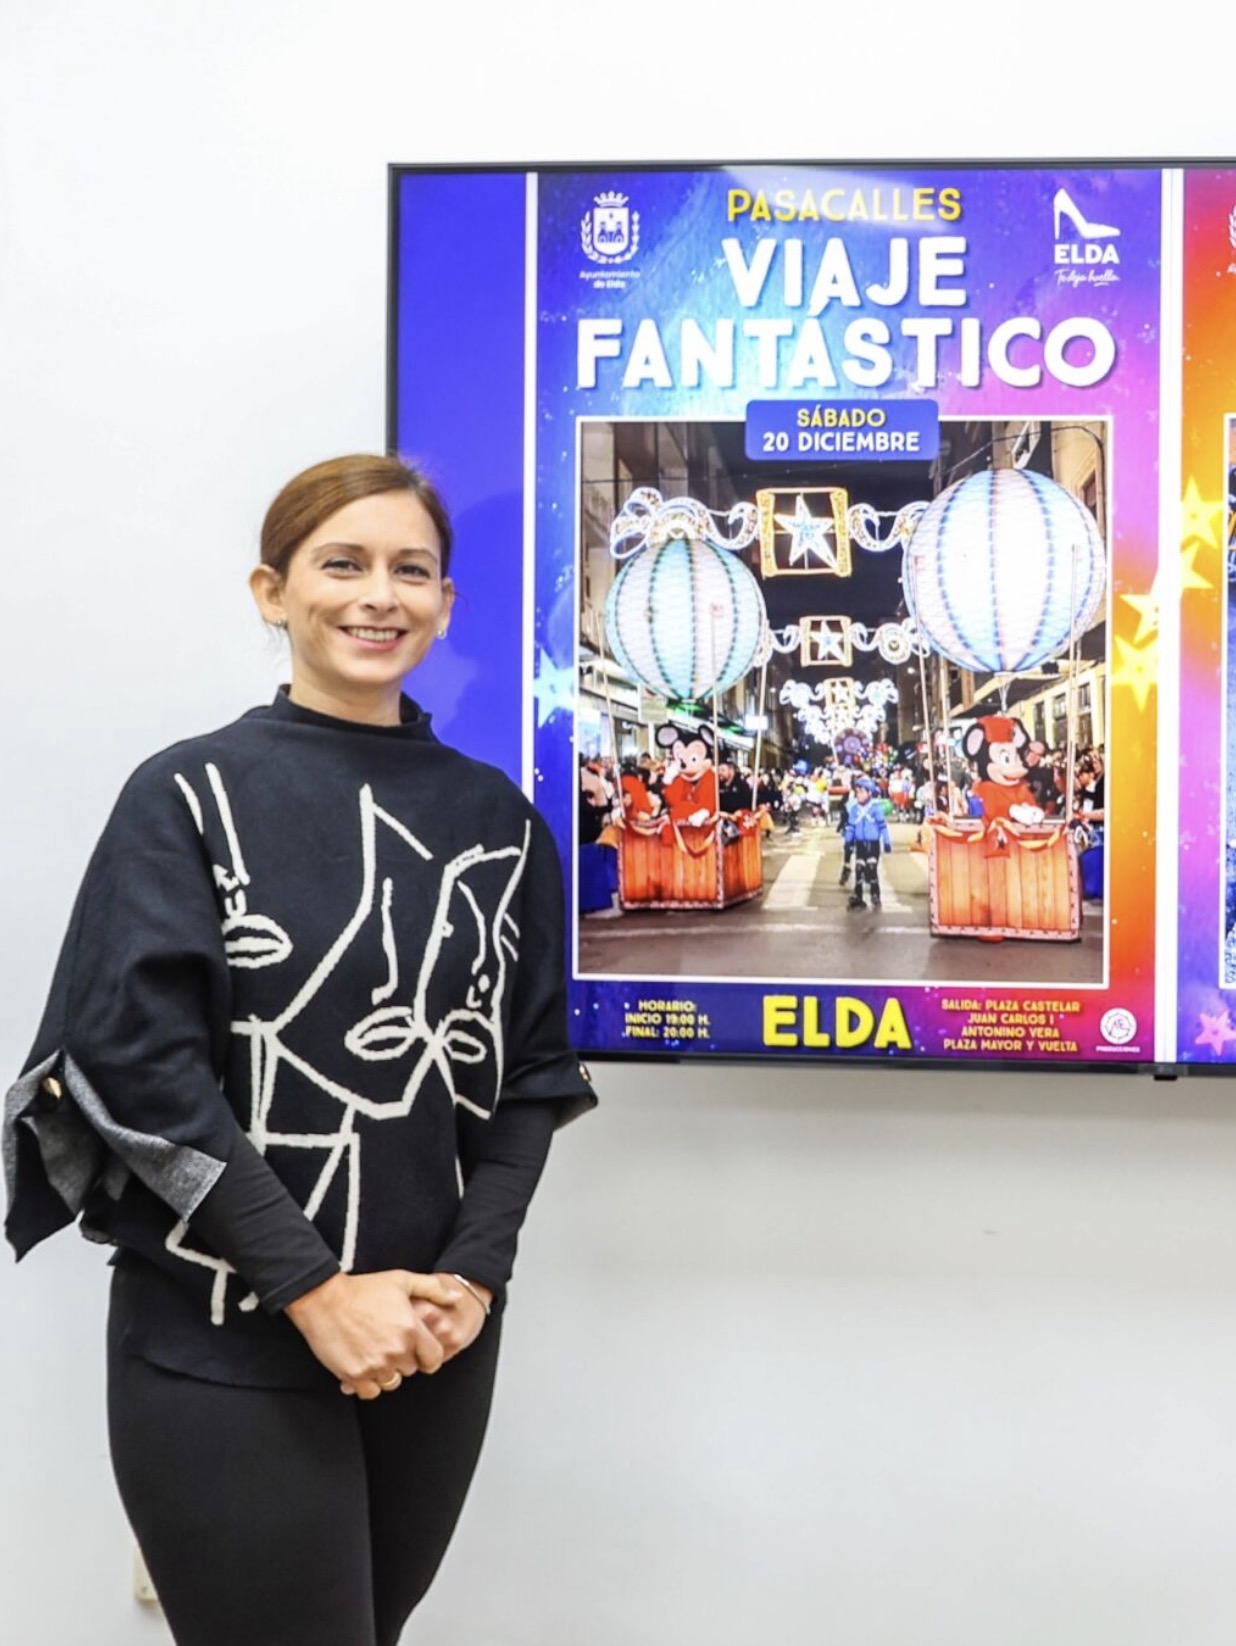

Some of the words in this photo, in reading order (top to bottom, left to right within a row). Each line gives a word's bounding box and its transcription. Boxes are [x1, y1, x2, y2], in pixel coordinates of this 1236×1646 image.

[728, 187, 962, 222] PASACALLES
[1054, 243, 1120, 265] ELDA
[721, 236, 967, 307] VIAJE
[576, 300, 1117, 389] FANTÁSTICO
[797, 404, 887, 428] SÁBADO
[763, 431, 790, 452] 20
[797, 431, 921, 452] DICIEMBRE
[941, 999, 982, 1011] SALIDA:
[985, 1000, 1019, 1012] PLAZA
[1022, 1000, 1081, 1013] CASTELAR
[625, 1011, 662, 1025] INICIO
[763, 994, 913, 1049] ELDA
[967, 1013, 997, 1025] JUAN
[1000, 1013, 1047, 1026] CARLOS
[1049, 1014, 1055, 1025] I
[961, 1025, 1026, 1038] ANTONINO
[1029, 1026, 1061, 1039] VERA
[943, 1037, 978, 1051] PLAZA
[981, 1038, 1023, 1052] MAYOR
[1025, 1039, 1035, 1052] Y
[1037, 1039, 1079, 1053] VUELTA
